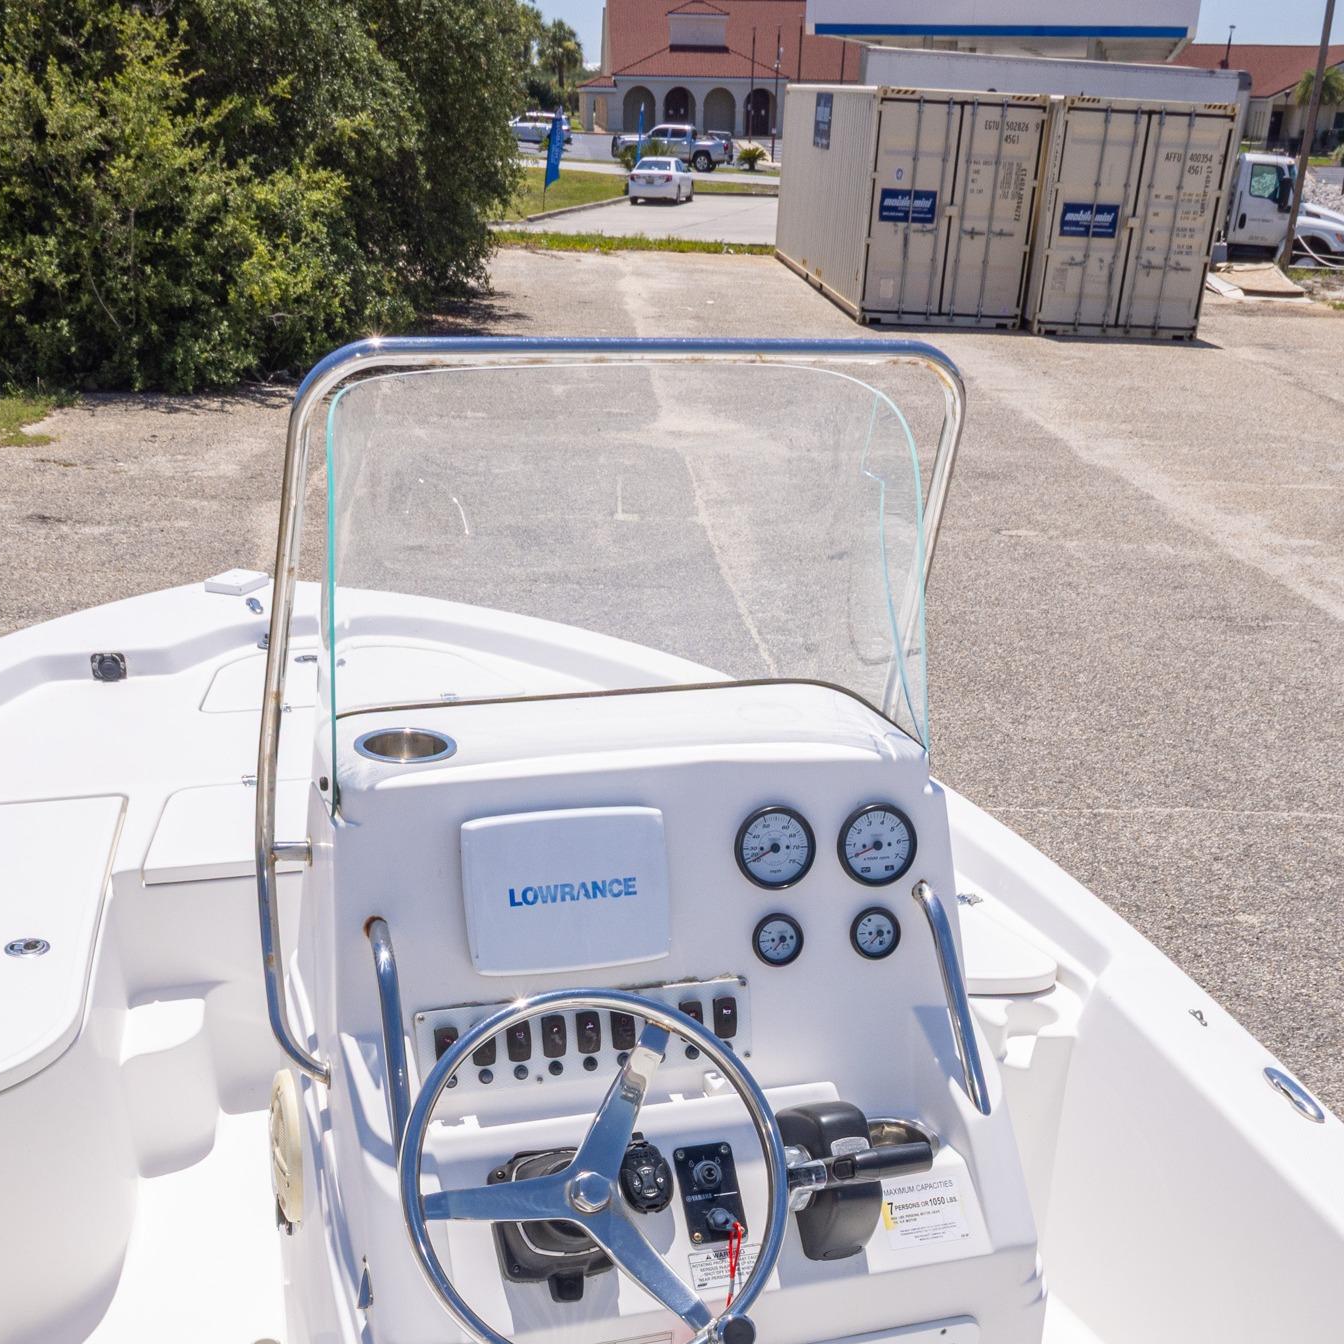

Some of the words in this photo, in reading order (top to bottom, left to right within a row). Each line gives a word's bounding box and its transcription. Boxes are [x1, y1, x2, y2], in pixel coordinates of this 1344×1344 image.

[985, 120, 1000, 131] EGTU
[1004, 134, 1020, 145] 45G1
[1164, 151, 1182, 163] AFFU
[1189, 152, 1213, 164] 400354
[1187, 165, 1203, 176] 45G1
[913, 197, 933, 208] mini
[1094, 211, 1115, 222] mini
[508, 876, 638, 907] LOWRANCE
[883, 1185, 915, 1197] MAXIMUM
[916, 1179, 954, 1192] CAPACITIES
[887, 1202, 894, 1215] 7
[895, 1201, 921, 1211] PERSONS
[929, 1196, 946, 1207] 1050
